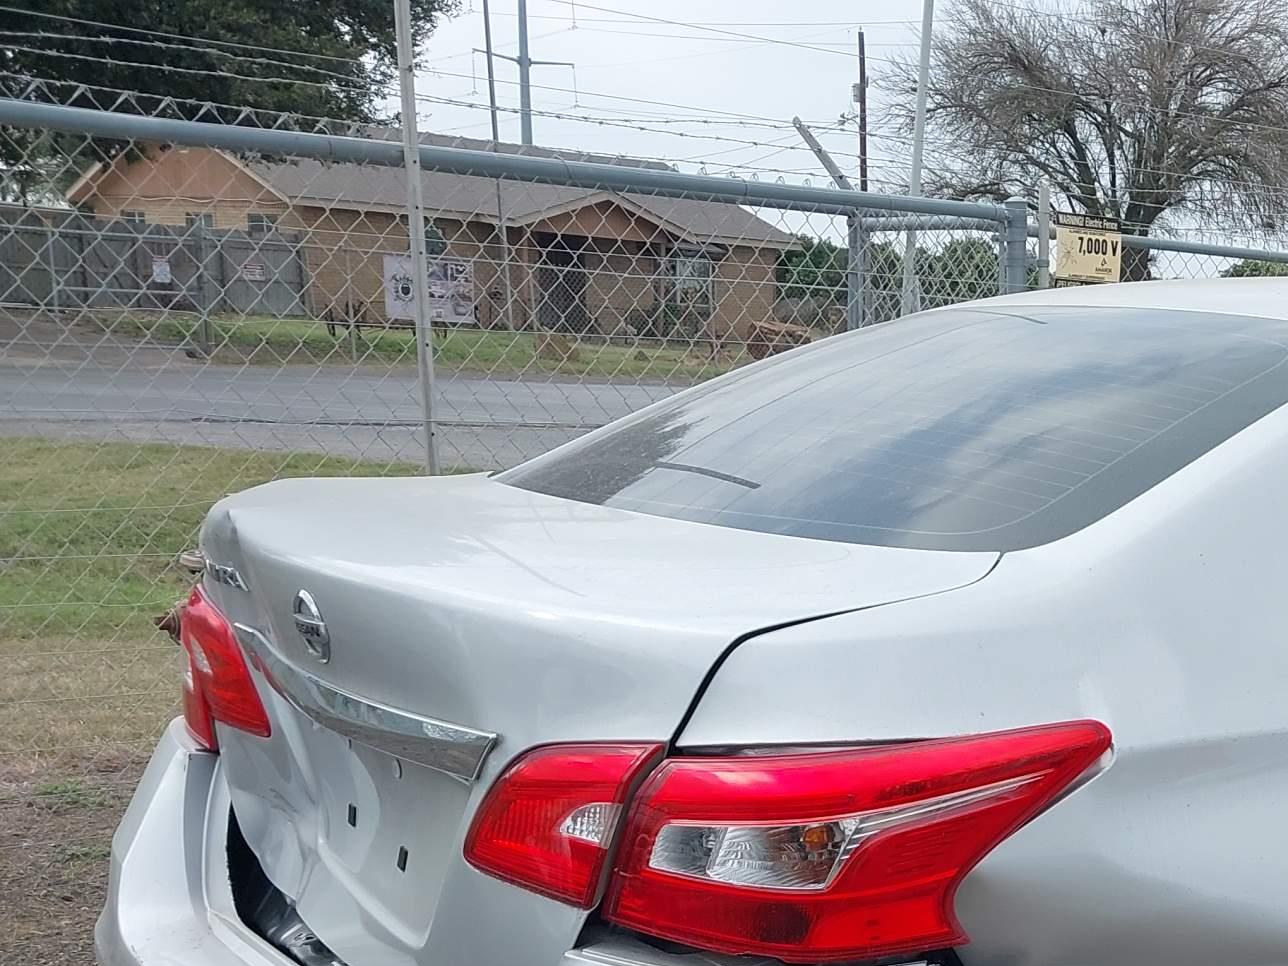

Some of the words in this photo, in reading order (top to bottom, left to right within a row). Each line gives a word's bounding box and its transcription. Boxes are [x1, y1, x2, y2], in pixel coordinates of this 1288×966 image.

[1103, 219, 1118, 230] Fence
[1078, 237, 1108, 256] 7,000
[1111, 241, 1119, 257] V
